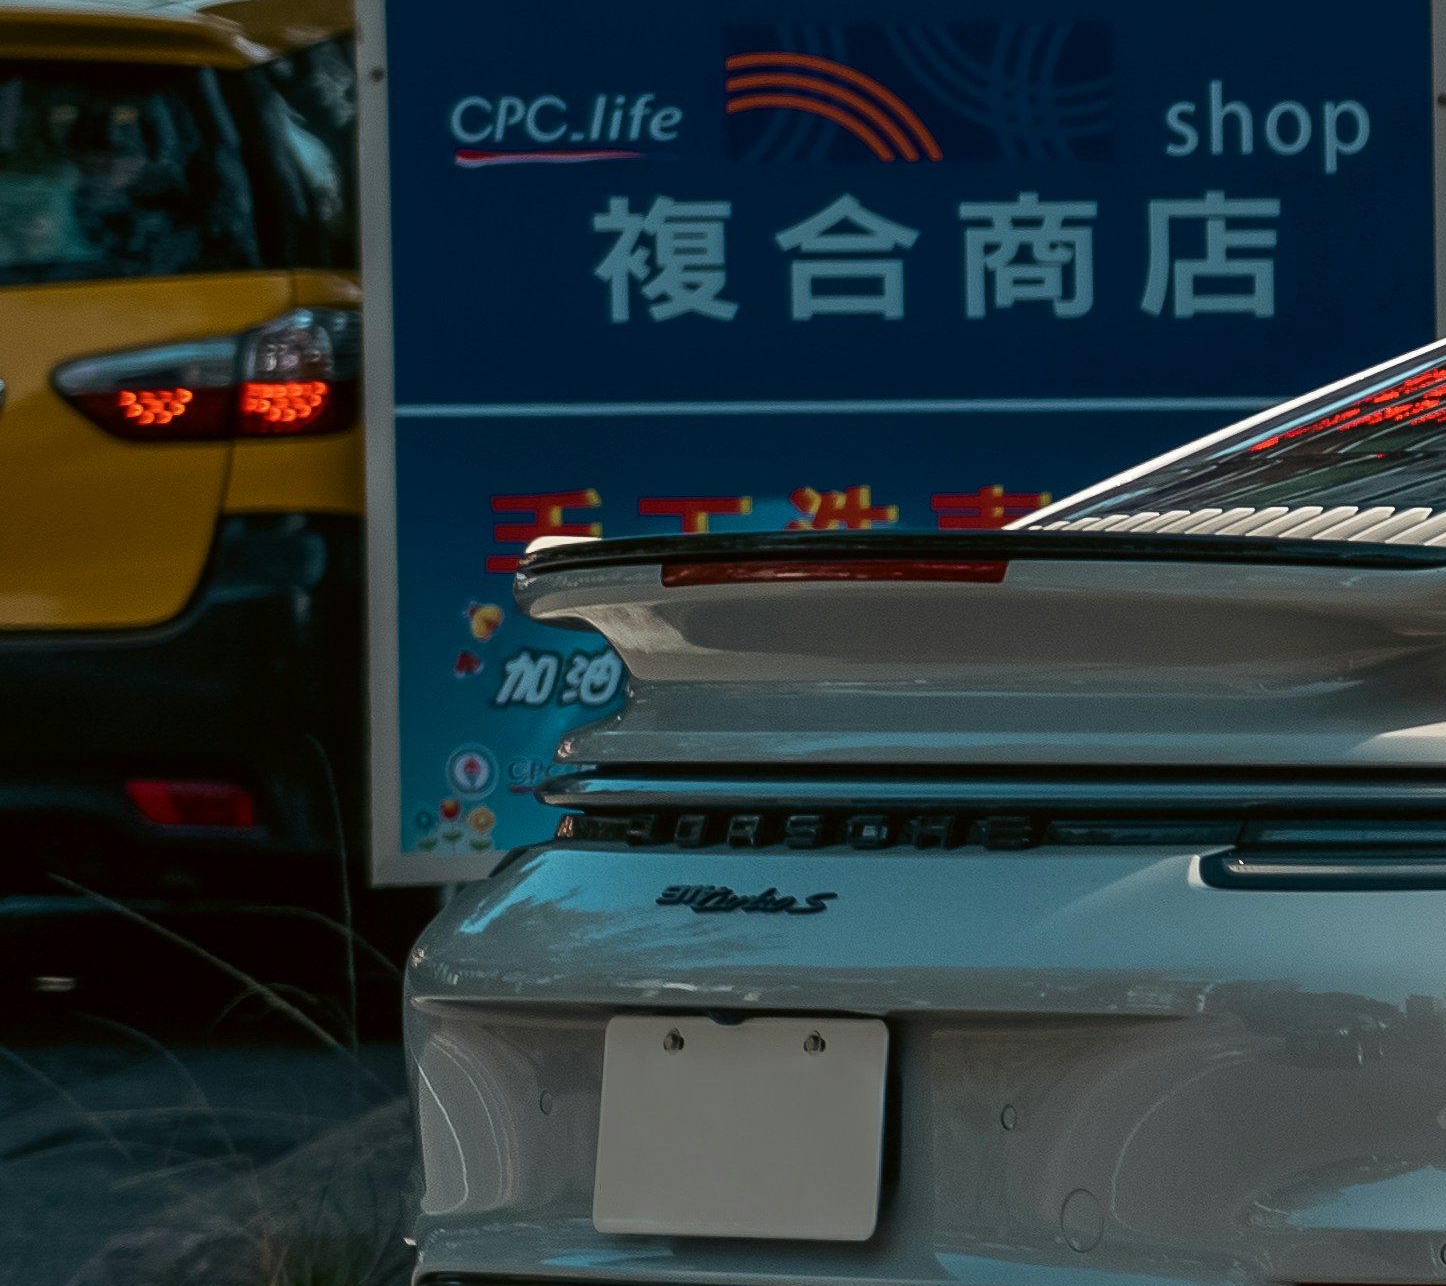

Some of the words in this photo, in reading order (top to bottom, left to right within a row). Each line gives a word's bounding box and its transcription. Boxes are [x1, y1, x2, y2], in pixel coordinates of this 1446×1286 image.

[1166, 82, 1371, 174] shop
[594, 191, 1281, 322] 複合商店
